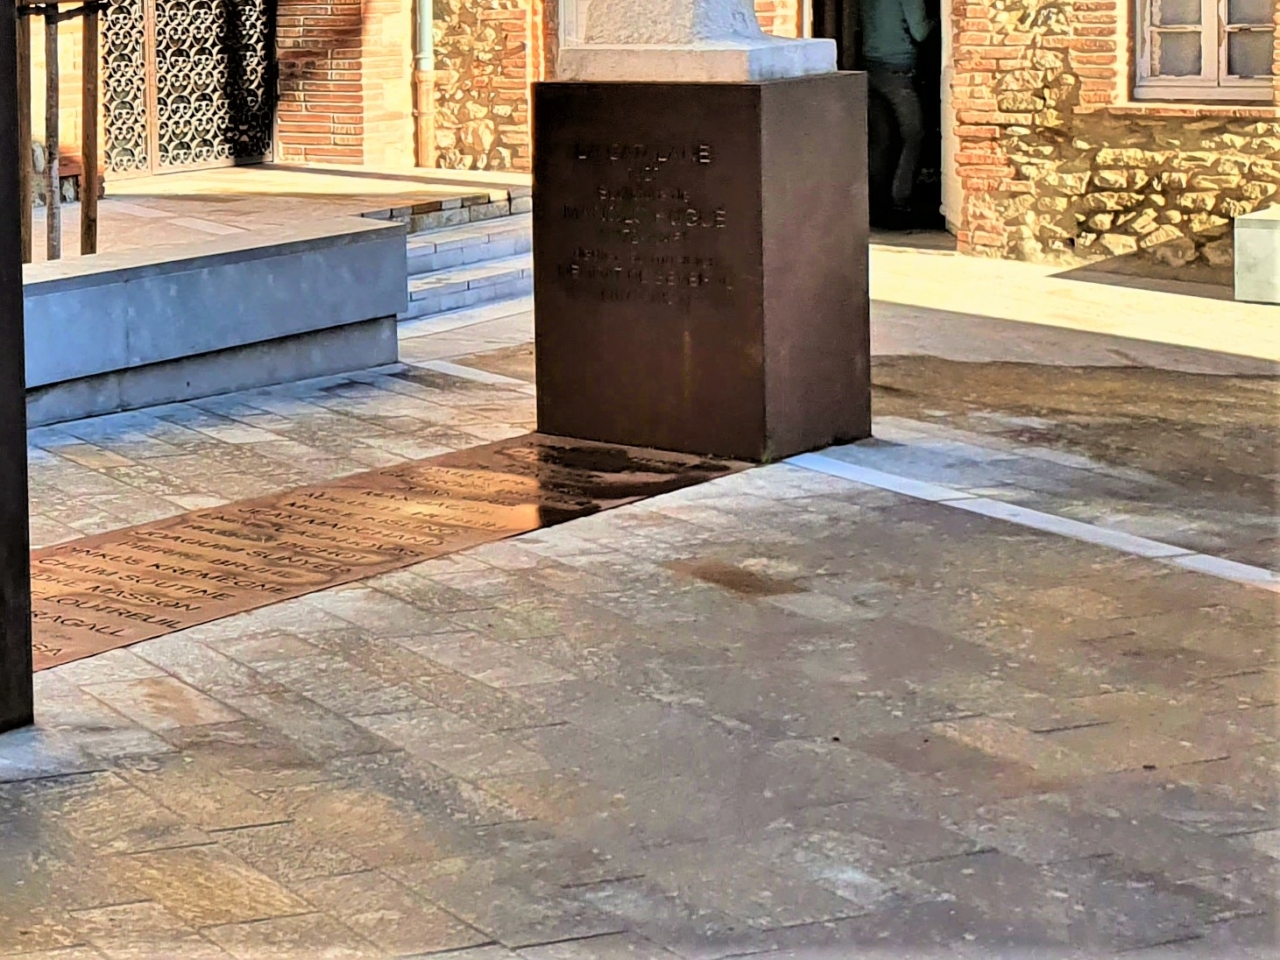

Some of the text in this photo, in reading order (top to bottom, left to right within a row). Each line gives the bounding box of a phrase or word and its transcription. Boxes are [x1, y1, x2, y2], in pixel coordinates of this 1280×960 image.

[84, 584, 202, 612] MASSON
[118, 573, 237, 601] SOUTINE
[42, 594, 182, 630] LOUTREUIL
